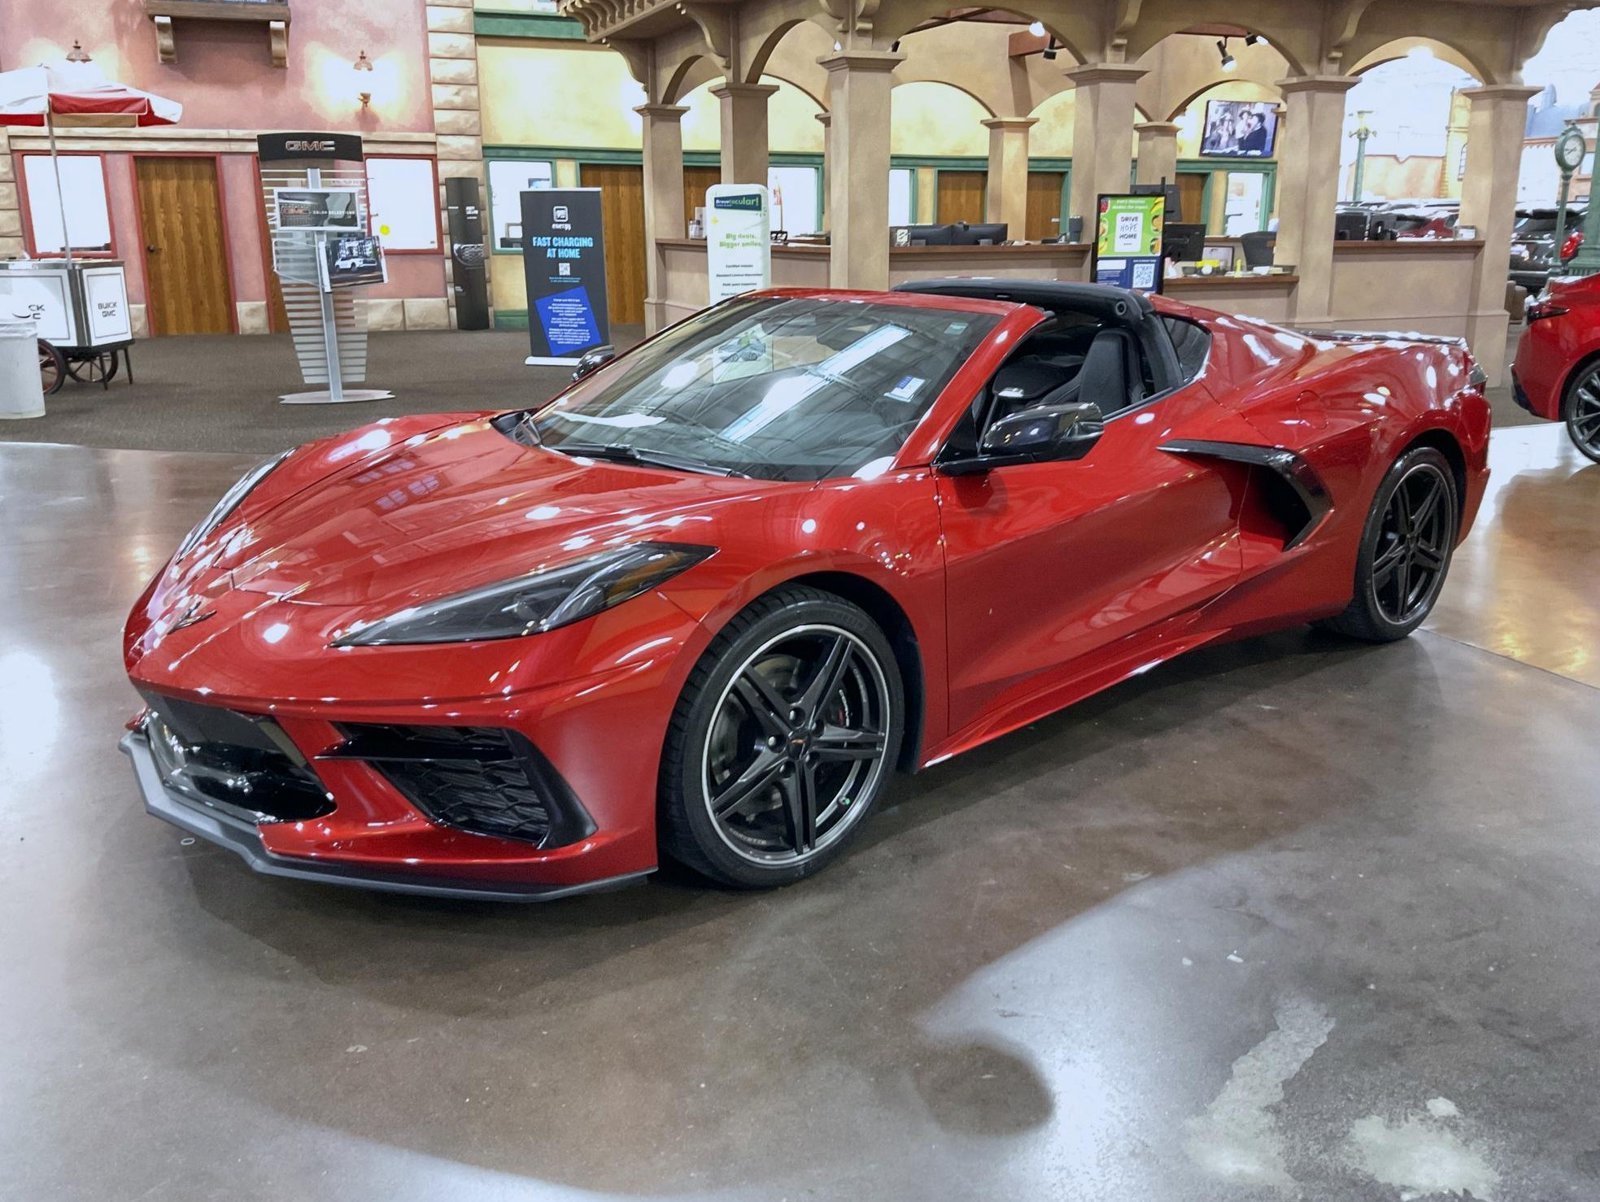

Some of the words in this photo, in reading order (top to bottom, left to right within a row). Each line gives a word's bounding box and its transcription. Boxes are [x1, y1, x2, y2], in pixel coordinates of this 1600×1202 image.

[285, 140, 336, 151] GMC
[532, 236, 552, 247] FAST
[552, 236, 594, 248] CHARGING
[546, 248, 557, 259] AT
[557, 248, 581, 259] HOME
[97, 302, 118, 310] BUICK
[101, 310, 116, 318] GMC
